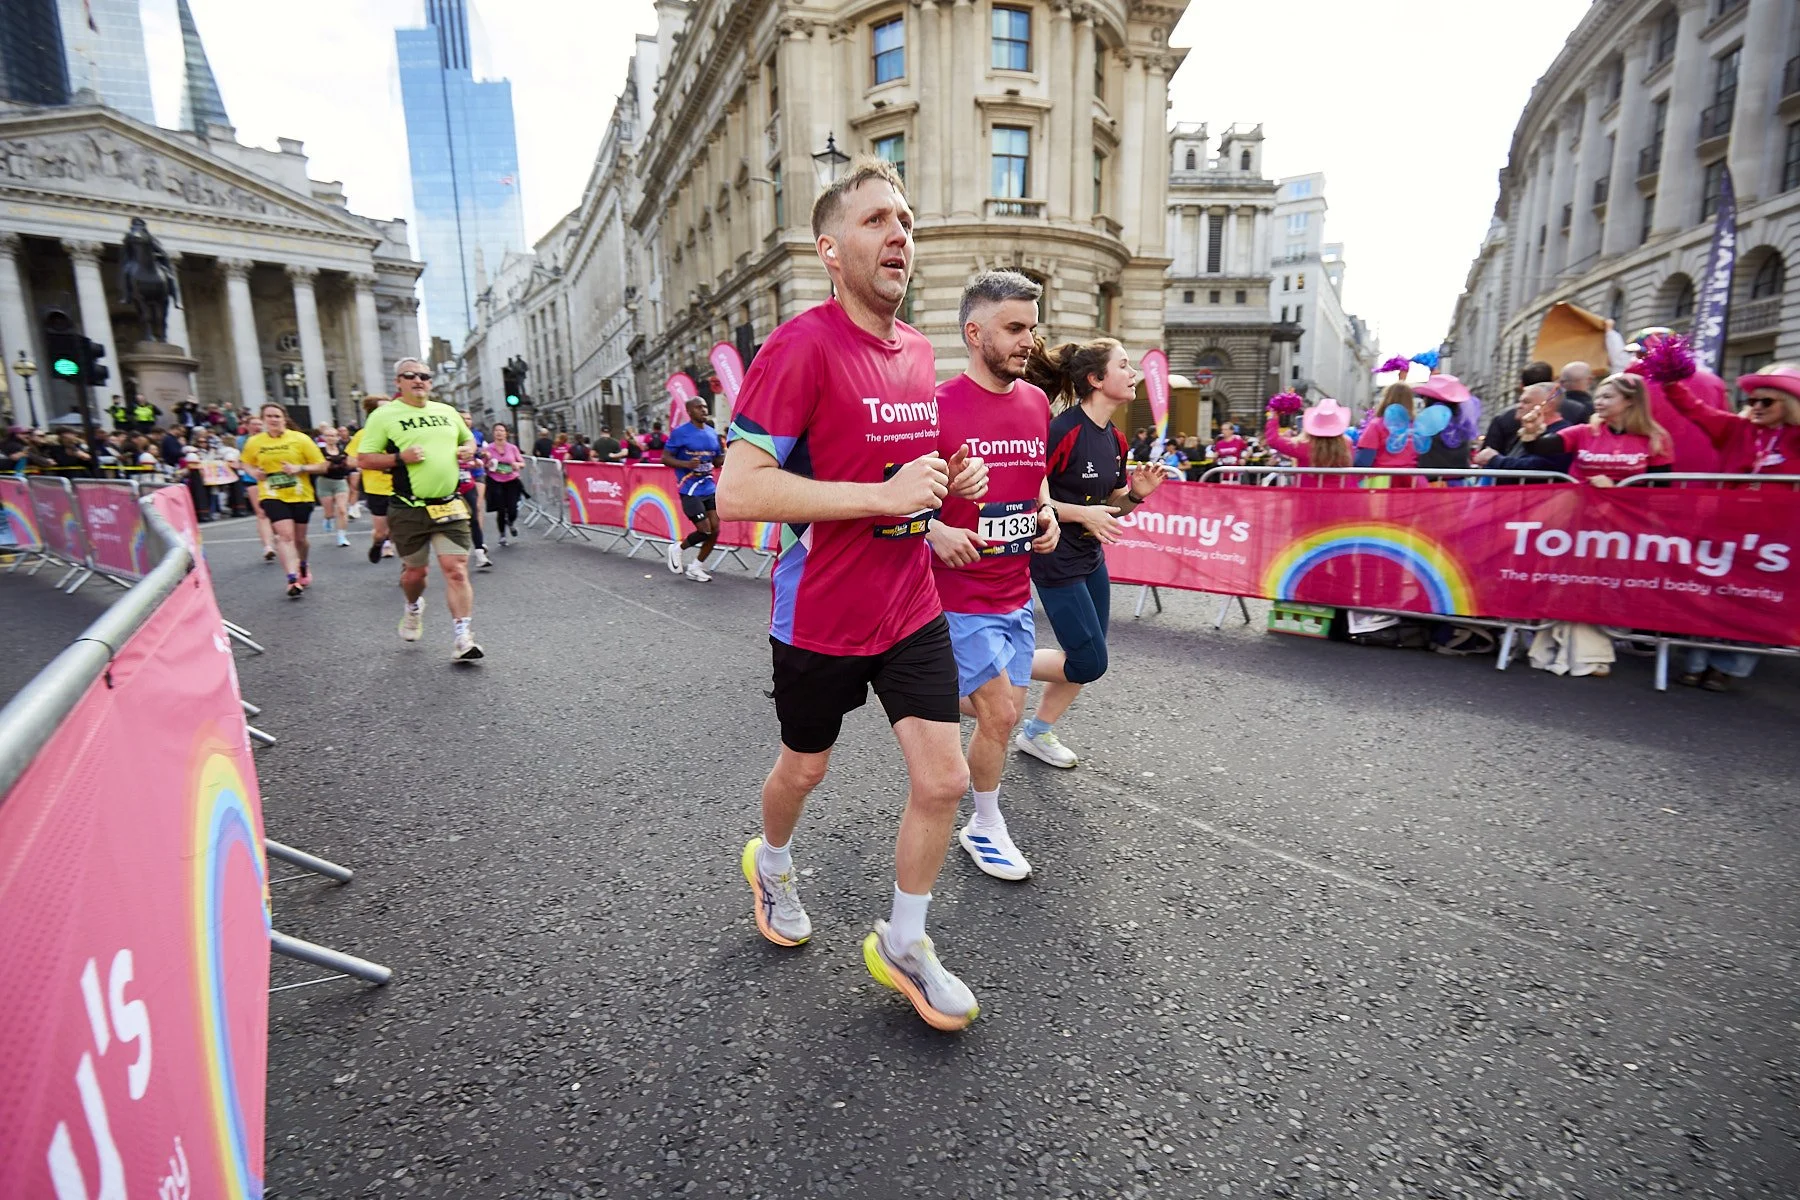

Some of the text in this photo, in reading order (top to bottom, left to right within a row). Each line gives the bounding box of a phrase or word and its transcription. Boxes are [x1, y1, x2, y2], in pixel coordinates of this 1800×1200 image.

[862, 396, 939, 426] Tommy'
[399, 415, 452, 431] MARK
[865, 433, 882, 442] The
[883, 432, 914, 443] pregnancy
[914, 430, 924, 438] and
[966, 437, 1045, 458] Tommy's
[1020, 460, 1034, 468] baby
[985, 515, 1036, 538] 11333
[1117, 510, 1250, 546] ommy's
[1165, 545, 1182, 554] and
[1183, 546, 1208, 560] baby
[1210, 551, 1247, 565] charity
[1505, 521, 1791, 577] Tommy's
[1500, 568, 1784, 602] The pregnancy and baby charity
